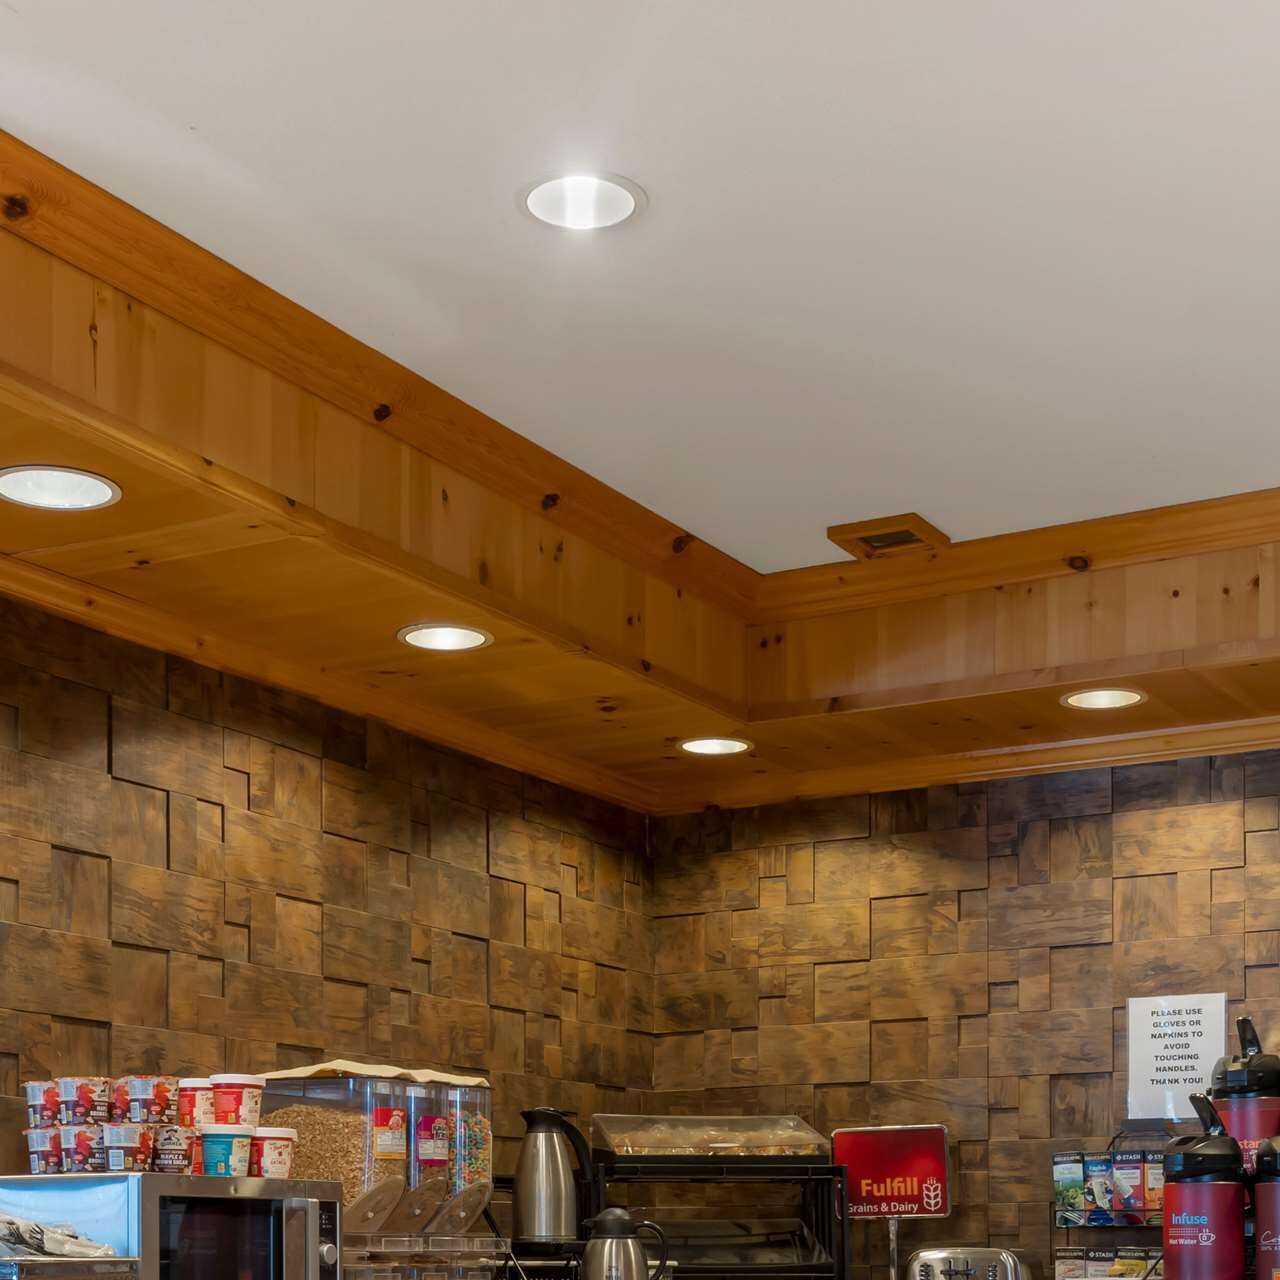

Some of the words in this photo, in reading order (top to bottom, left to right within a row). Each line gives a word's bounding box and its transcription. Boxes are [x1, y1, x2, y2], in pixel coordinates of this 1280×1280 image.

[1151, 1009, 1183, 1017] PLEASE
[1152, 1020, 1186, 1028] GLOVES
[1151, 1031, 1189, 1039] NAPKINS
[1163, 1042, 1190, 1050] AVOID
[1154, 1053, 1199, 1061] TOUCHING
[1182, 1077, 1204, 1085] YOU!
[861, 1177, 918, 1197] Fulfill
[880, 1202, 889, 1212] &
[891, 1201, 919, 1213] Dairy
[1172, 1213, 1208, 1225] Infuse
